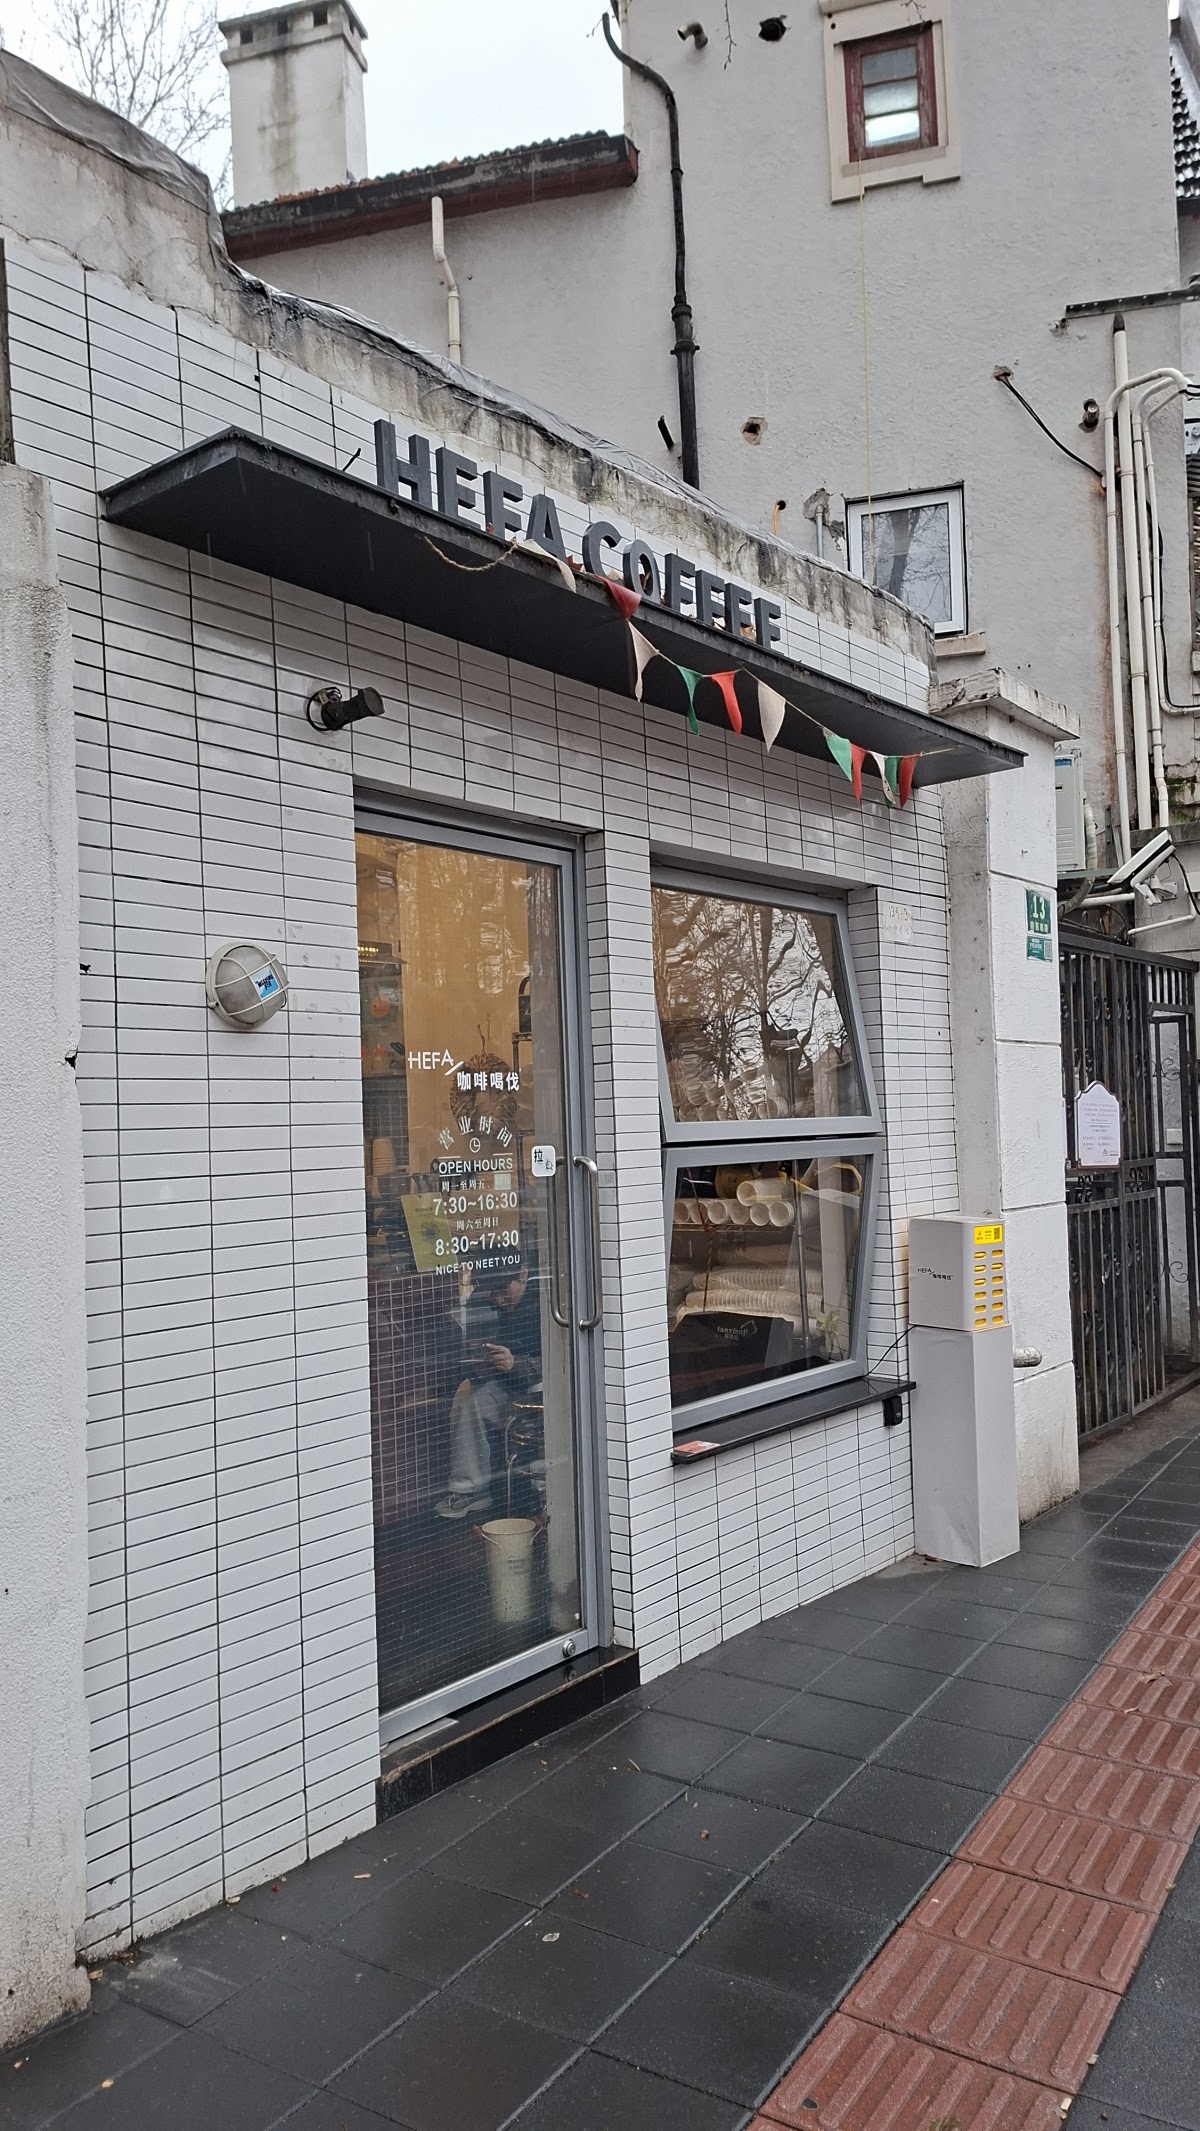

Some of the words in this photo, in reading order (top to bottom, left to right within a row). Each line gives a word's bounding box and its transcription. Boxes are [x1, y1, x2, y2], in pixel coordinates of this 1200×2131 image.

[374, 418, 568, 564] HEFA
[582, 520, 781, 648] COFFEE
[1032, 894, 1046, 920] 13
[408, 1048, 454, 1070] HEFA
[456, 1071, 520, 1091] 咖啡喝伐
[437, 1115, 513, 1150] 营业时间
[438, 1160, 472, 1175] OPEN
[473, 1157, 514, 1172] HOURS
[534, 1149, 544, 1163] 拉
[432, 1191, 518, 1216] 7:30~16:30
[456, 1216, 499, 1231] 周六至周日
[435, 1229, 519, 1256] 8:30~17:30
[435, 1263, 459, 1276] NICE
[461, 1260, 474, 1271] TO
[501, 1254, 521, 1266] YOU
